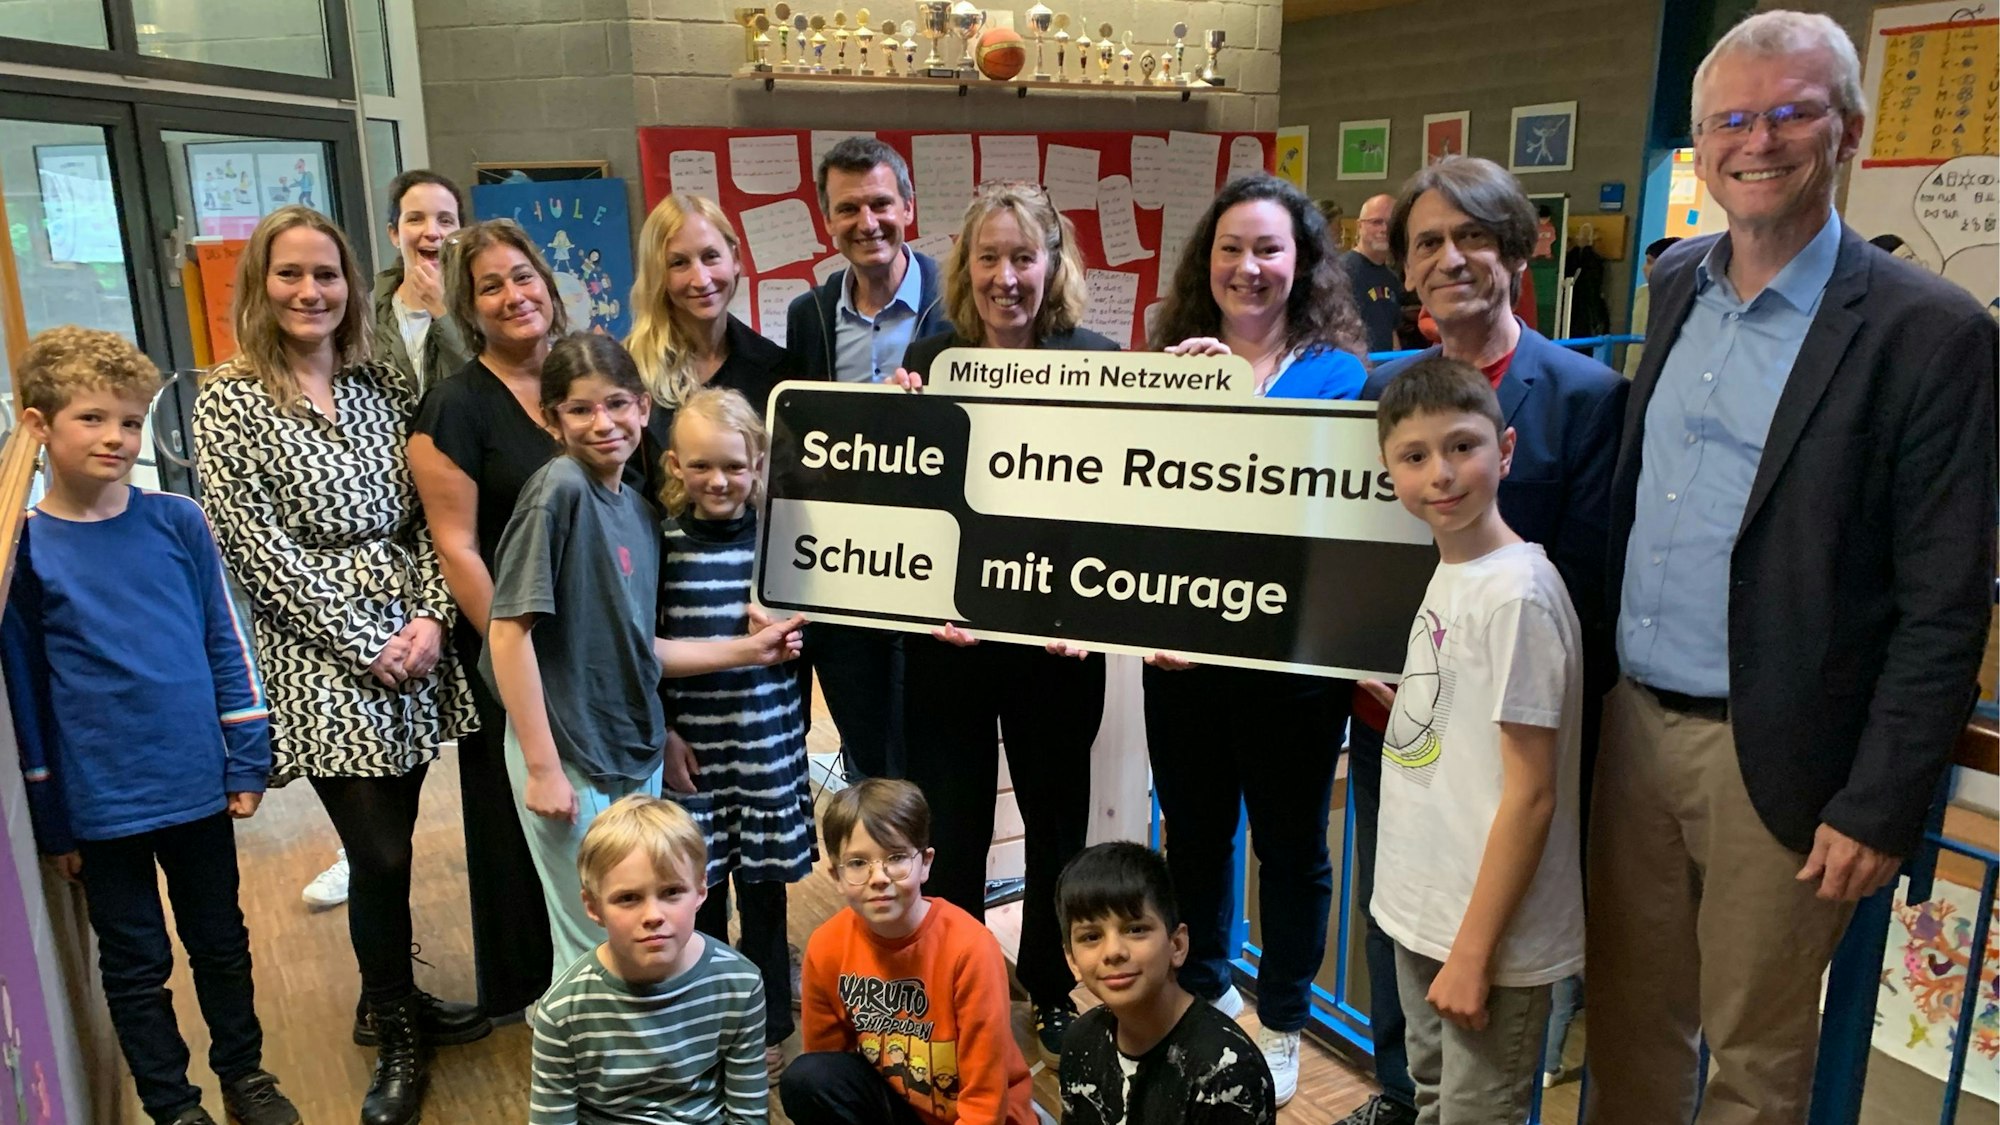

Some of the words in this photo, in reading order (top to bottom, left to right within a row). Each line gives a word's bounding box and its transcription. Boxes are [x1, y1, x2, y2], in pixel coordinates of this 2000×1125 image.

[949, 361, 1051, 390] Mitglied
[1059, 364, 1090, 386] im
[1100, 366, 1233, 391] Netzwerk
[801, 430, 944, 476] Schule
[988, 443, 1102, 485] ohne
[1123, 448, 1399, 502] Rassismus
[792, 534, 933, 581] Schule
[981, 552, 1054, 594] mit
[1070, 556, 1288, 622] Courage
[838, 973, 928, 1017] NARUTO
[854, 1012, 935, 1041] SHIPPUDEN
